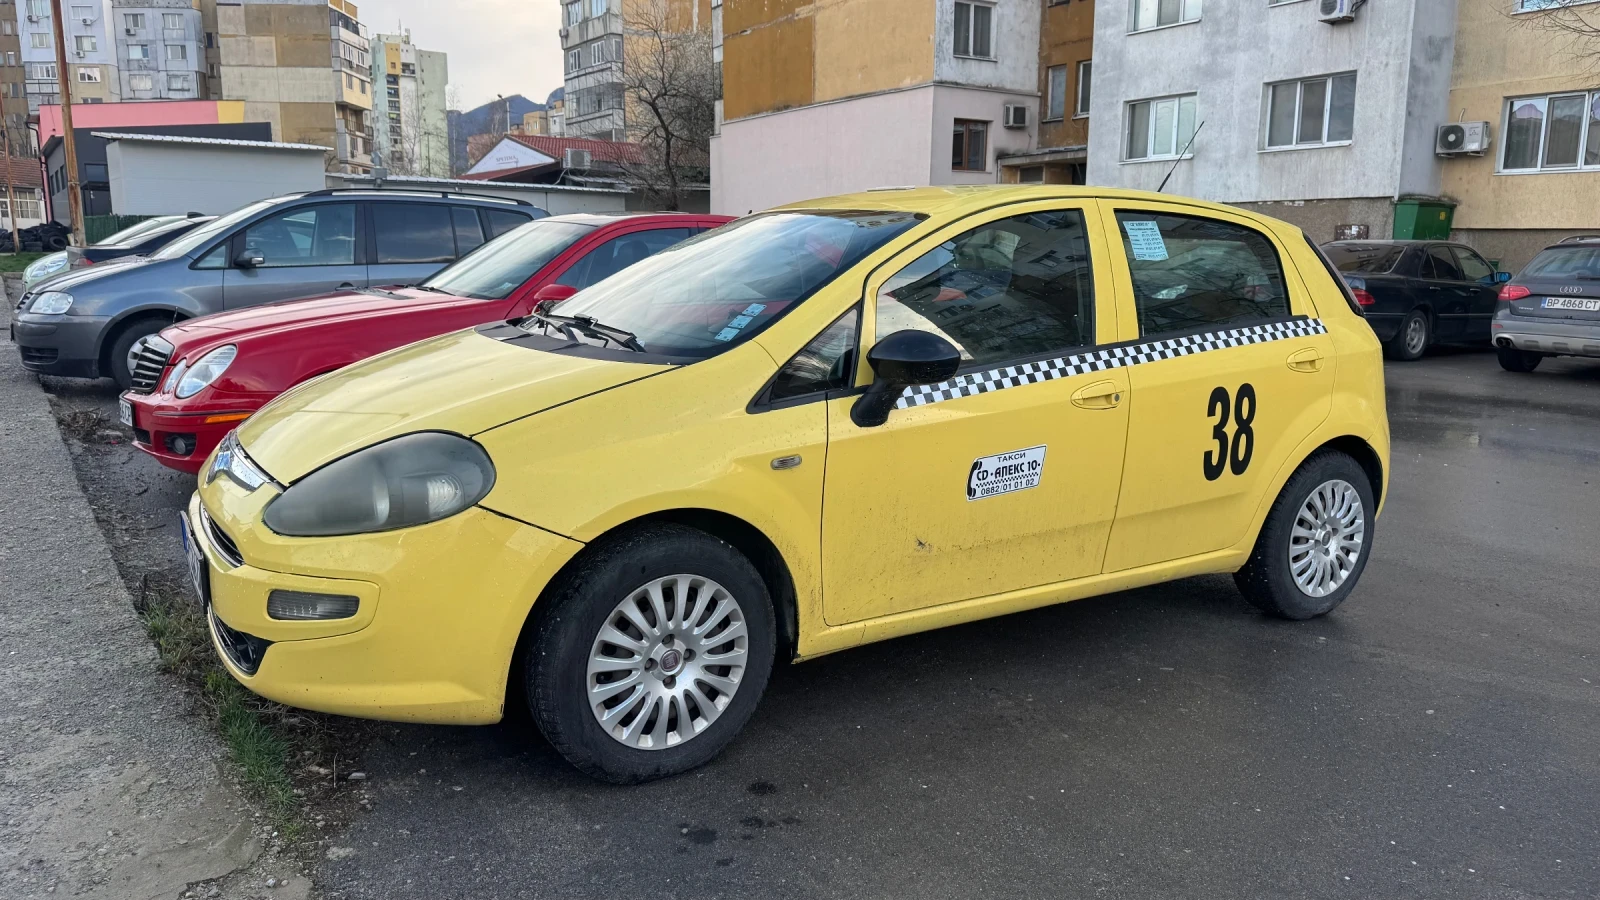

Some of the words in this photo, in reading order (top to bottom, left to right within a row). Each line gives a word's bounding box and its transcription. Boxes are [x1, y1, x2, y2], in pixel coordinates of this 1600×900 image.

[1546, 299, 1559, 307] BP
[1560, 299, 1584, 308] 4868
[1585, 300, 1599, 310] CT
[1203, 383, 1257, 481] 38
[997, 452, 1026, 463] ТАКСИ
[980, 483, 1012, 496] 0882/01
[1014, 481, 1023, 489] 01
[1025, 478, 1035, 486] 02
